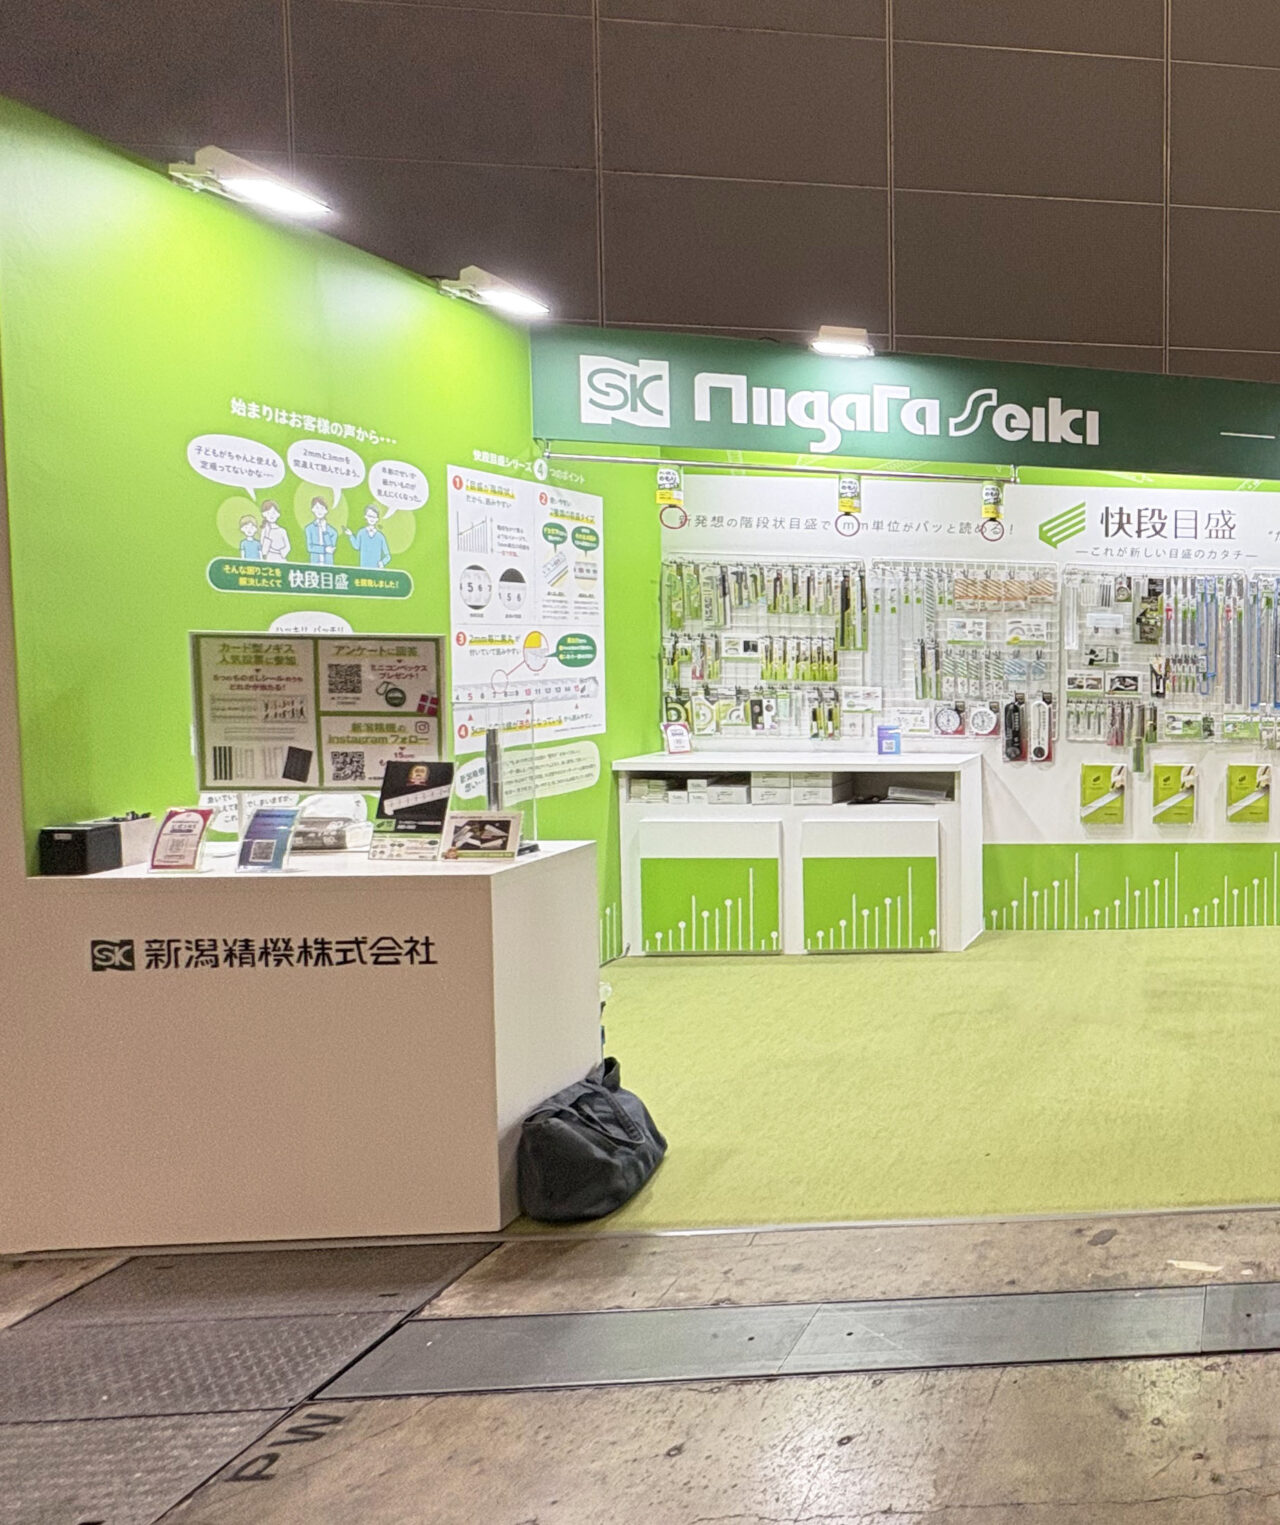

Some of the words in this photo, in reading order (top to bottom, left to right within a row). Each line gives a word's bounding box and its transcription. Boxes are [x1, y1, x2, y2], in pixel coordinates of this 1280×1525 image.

[584, 362, 667, 420] SK
[695, 372, 940, 453] Niigata
[949, 389, 1099, 446] Seiki
[1100, 506, 1236, 540] 快段目盛
[288, 569, 349, 590] 快段目盛
[219, 643, 295, 654] カード型ノギス
[92, 943, 135, 969] SK
[145, 936, 438, 970] 新潟精機株式会社
